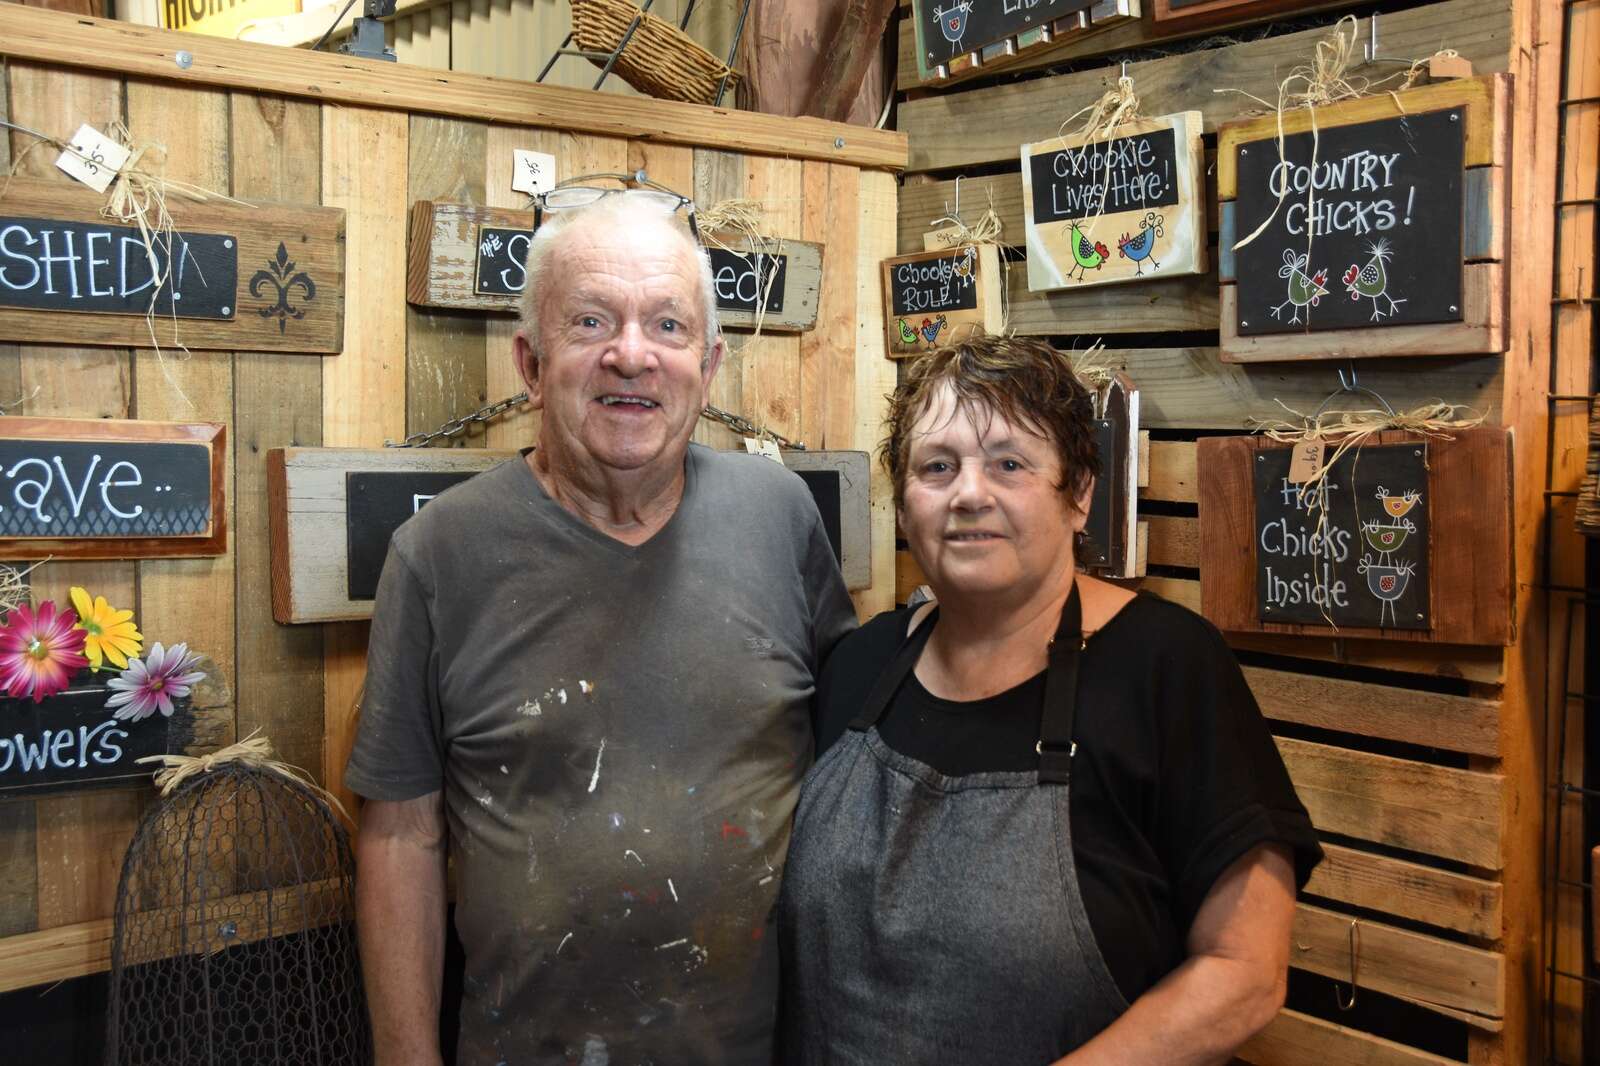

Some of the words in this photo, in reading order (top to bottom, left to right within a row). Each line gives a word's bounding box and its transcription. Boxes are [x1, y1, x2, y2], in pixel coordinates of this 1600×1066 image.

[1269, 150, 1401, 198] COUNTRY
[1051, 183, 1104, 215] Lives
[1261, 514, 1350, 563] Chicks
[1264, 562, 1349, 608] Inside
